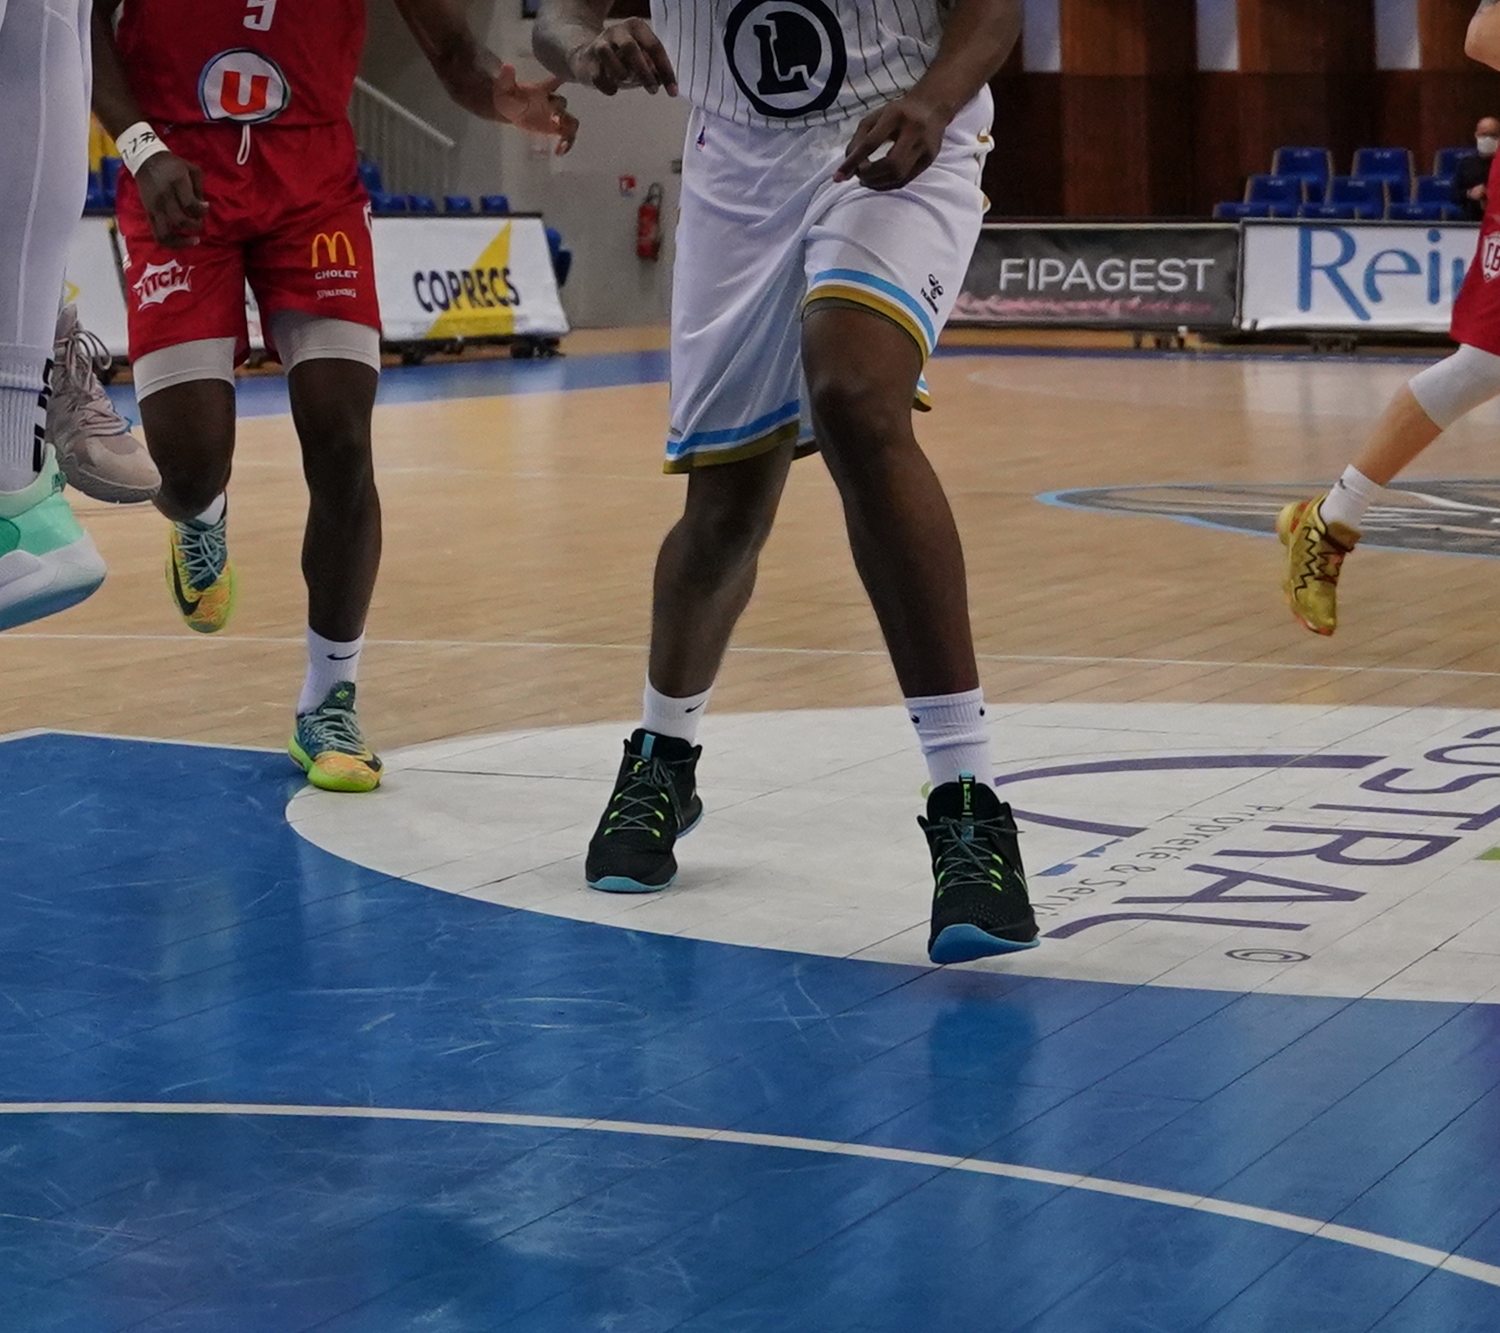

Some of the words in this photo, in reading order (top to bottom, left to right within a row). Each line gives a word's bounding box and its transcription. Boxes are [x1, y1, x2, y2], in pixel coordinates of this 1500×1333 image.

[314, 270, 358, 280] CHOLET
[413, 267, 521, 313] COPRECS
[1000, 258, 1215, 292] FIPAGEST
[1297, 227, 1466, 321] Rei
[1030, 878, 1127, 917] Servi
